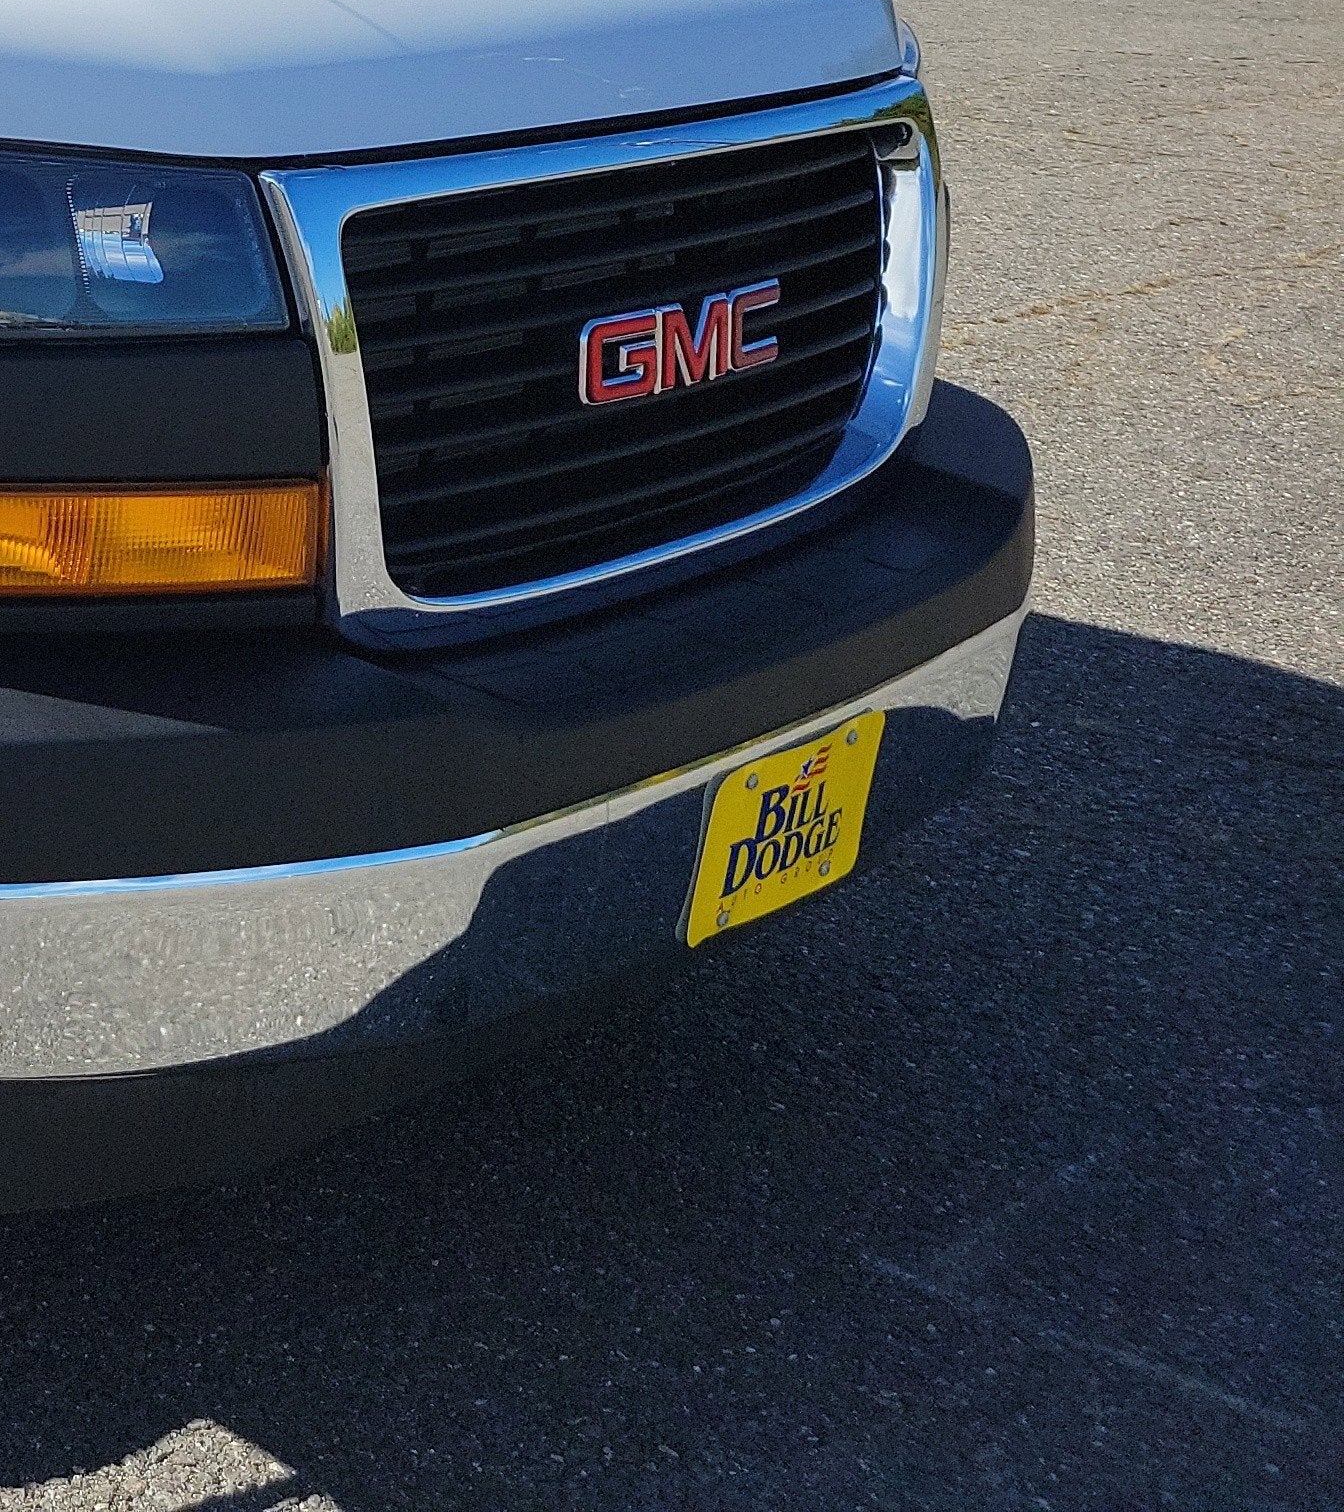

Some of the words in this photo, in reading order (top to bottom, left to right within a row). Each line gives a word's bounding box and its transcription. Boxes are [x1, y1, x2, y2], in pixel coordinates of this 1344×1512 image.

[578, 278, 781, 405] GMC
[719, 807, 844, 899] DODGE
[755, 782, 830, 843] BILL
